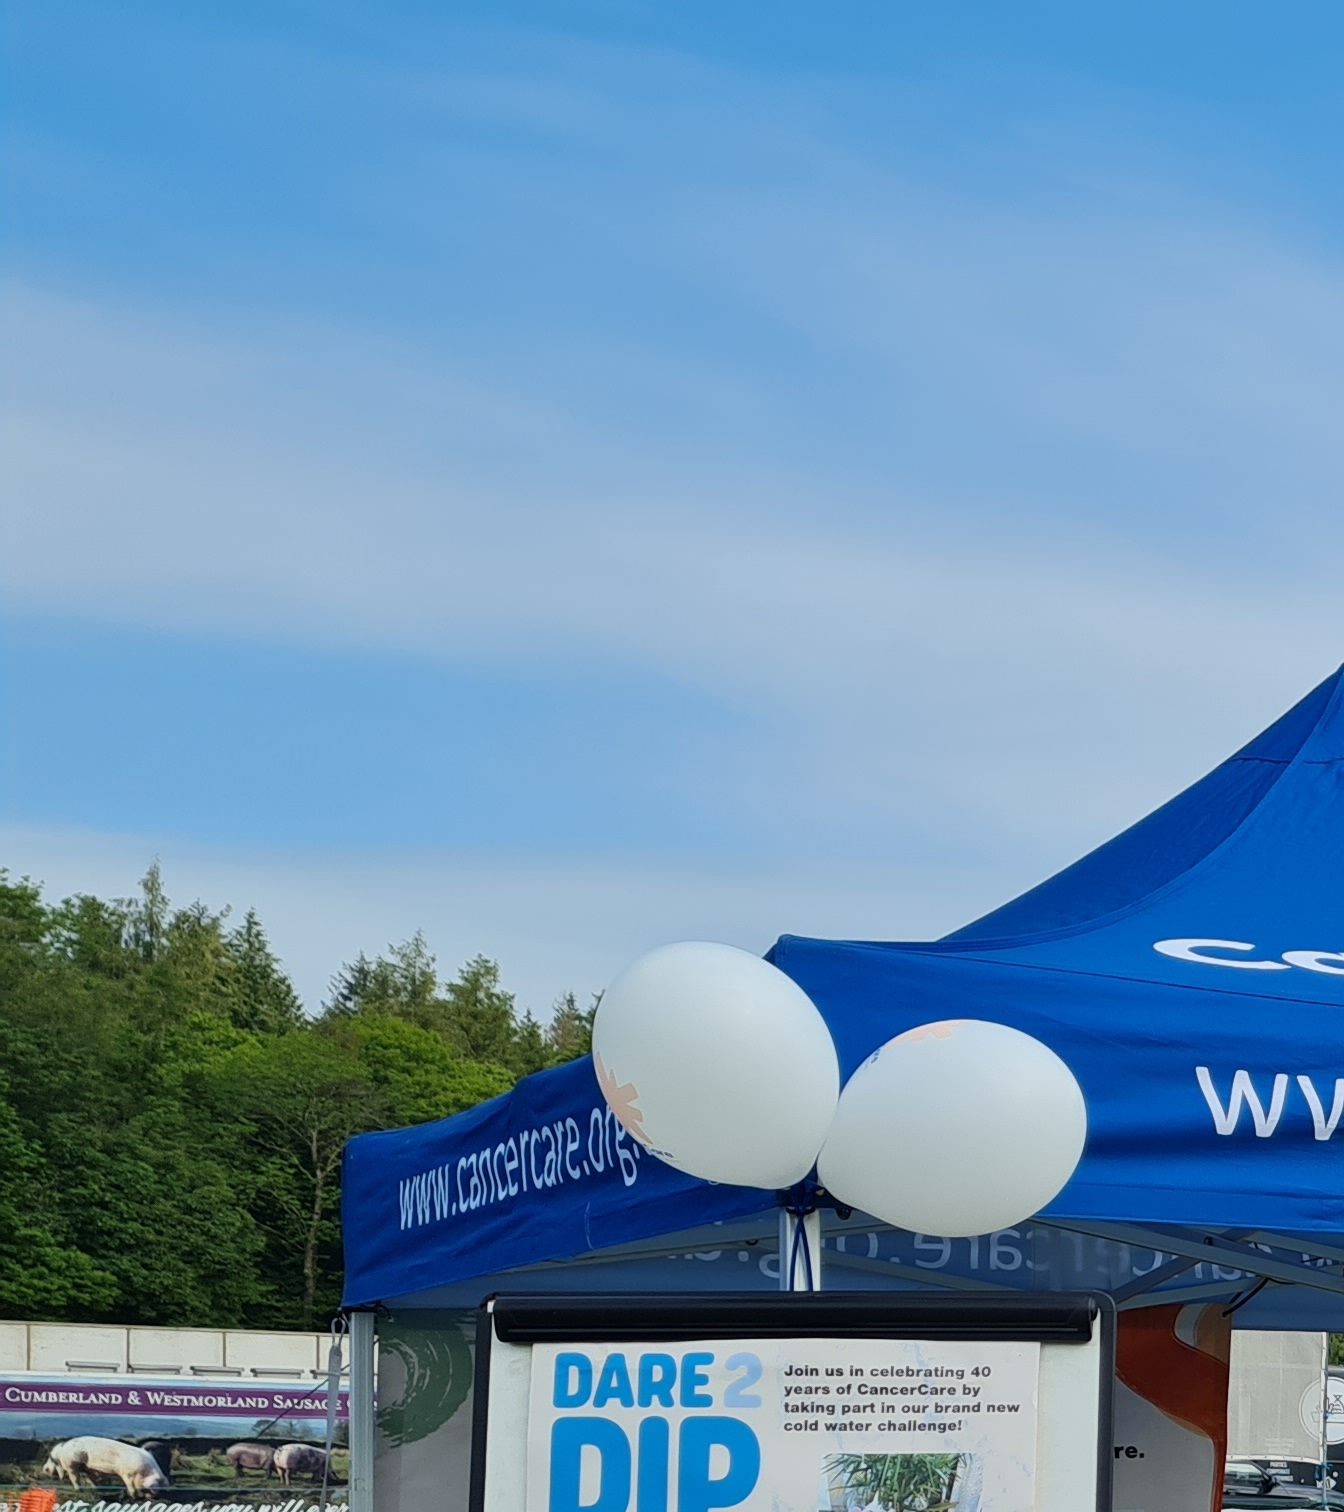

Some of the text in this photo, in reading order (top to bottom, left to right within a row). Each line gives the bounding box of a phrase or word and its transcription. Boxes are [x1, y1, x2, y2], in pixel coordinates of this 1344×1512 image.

[399, 1103, 640, 1230] www.cancercare.org.
[553, 1352, 762, 1408] DARE 2
[784, 1365, 991, 1380] Join us in celebrating 40
[784, 1383, 981, 1397] years of CancerCare by
[128, 1391, 142, 1406] &
[784, 1401, 1020, 1416] taking part in our brand new
[784, 1420, 962, 1434] cold water challenge!
